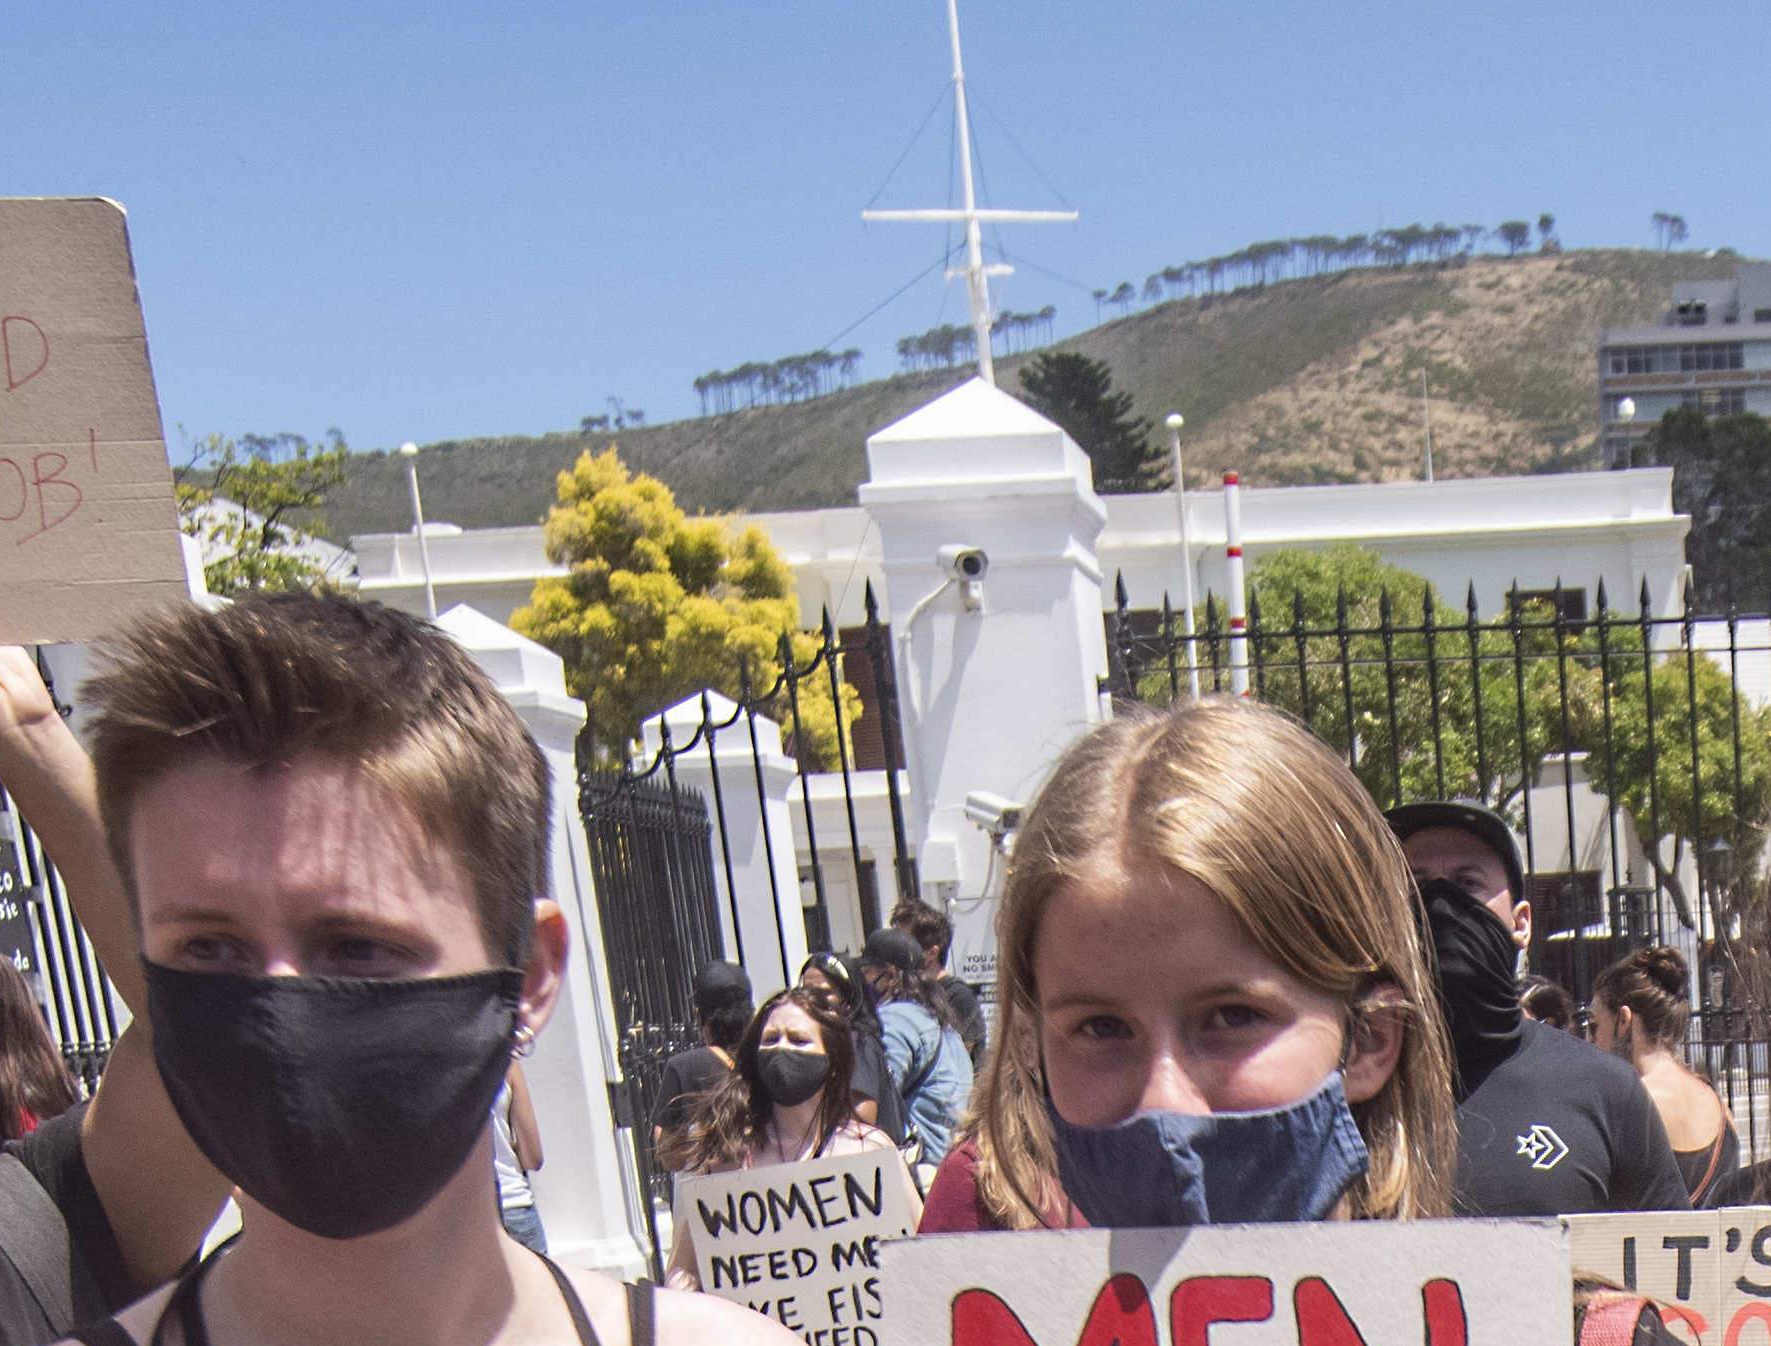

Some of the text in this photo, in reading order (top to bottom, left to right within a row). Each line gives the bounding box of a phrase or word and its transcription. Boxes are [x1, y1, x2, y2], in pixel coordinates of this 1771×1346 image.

[696, 1166, 883, 1239] WOMEN
[711, 1233, 889, 1289] NEED ME
